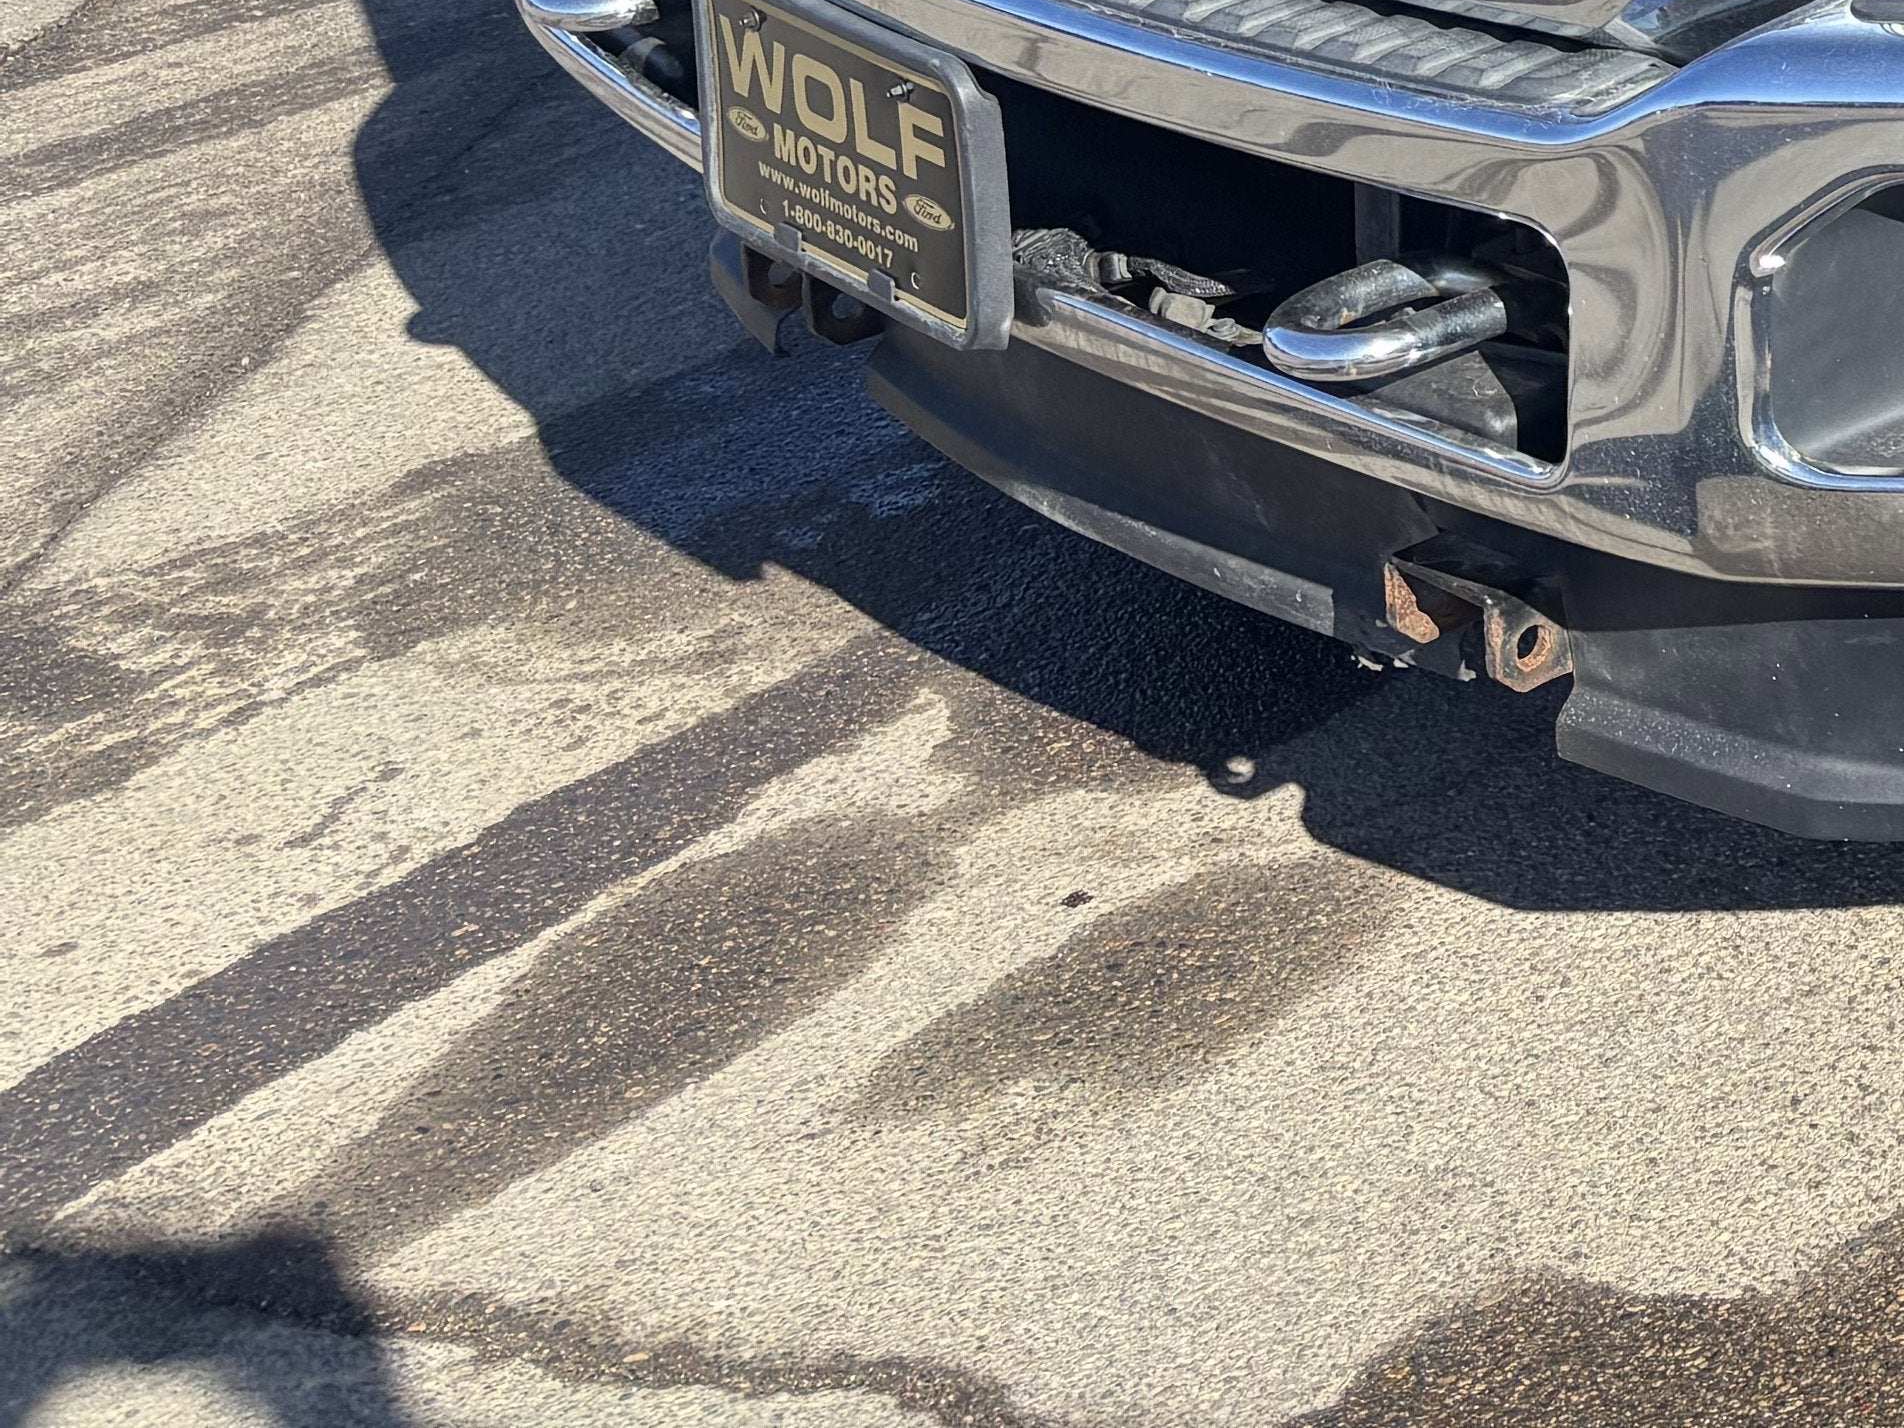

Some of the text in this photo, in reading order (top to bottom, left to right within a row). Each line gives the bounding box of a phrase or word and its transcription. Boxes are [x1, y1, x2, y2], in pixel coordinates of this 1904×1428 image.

[719, 14, 946, 180] WOLF
[758, 160, 919, 253] www.wolfmotors.com
[773, 123, 897, 215] MOTORS
